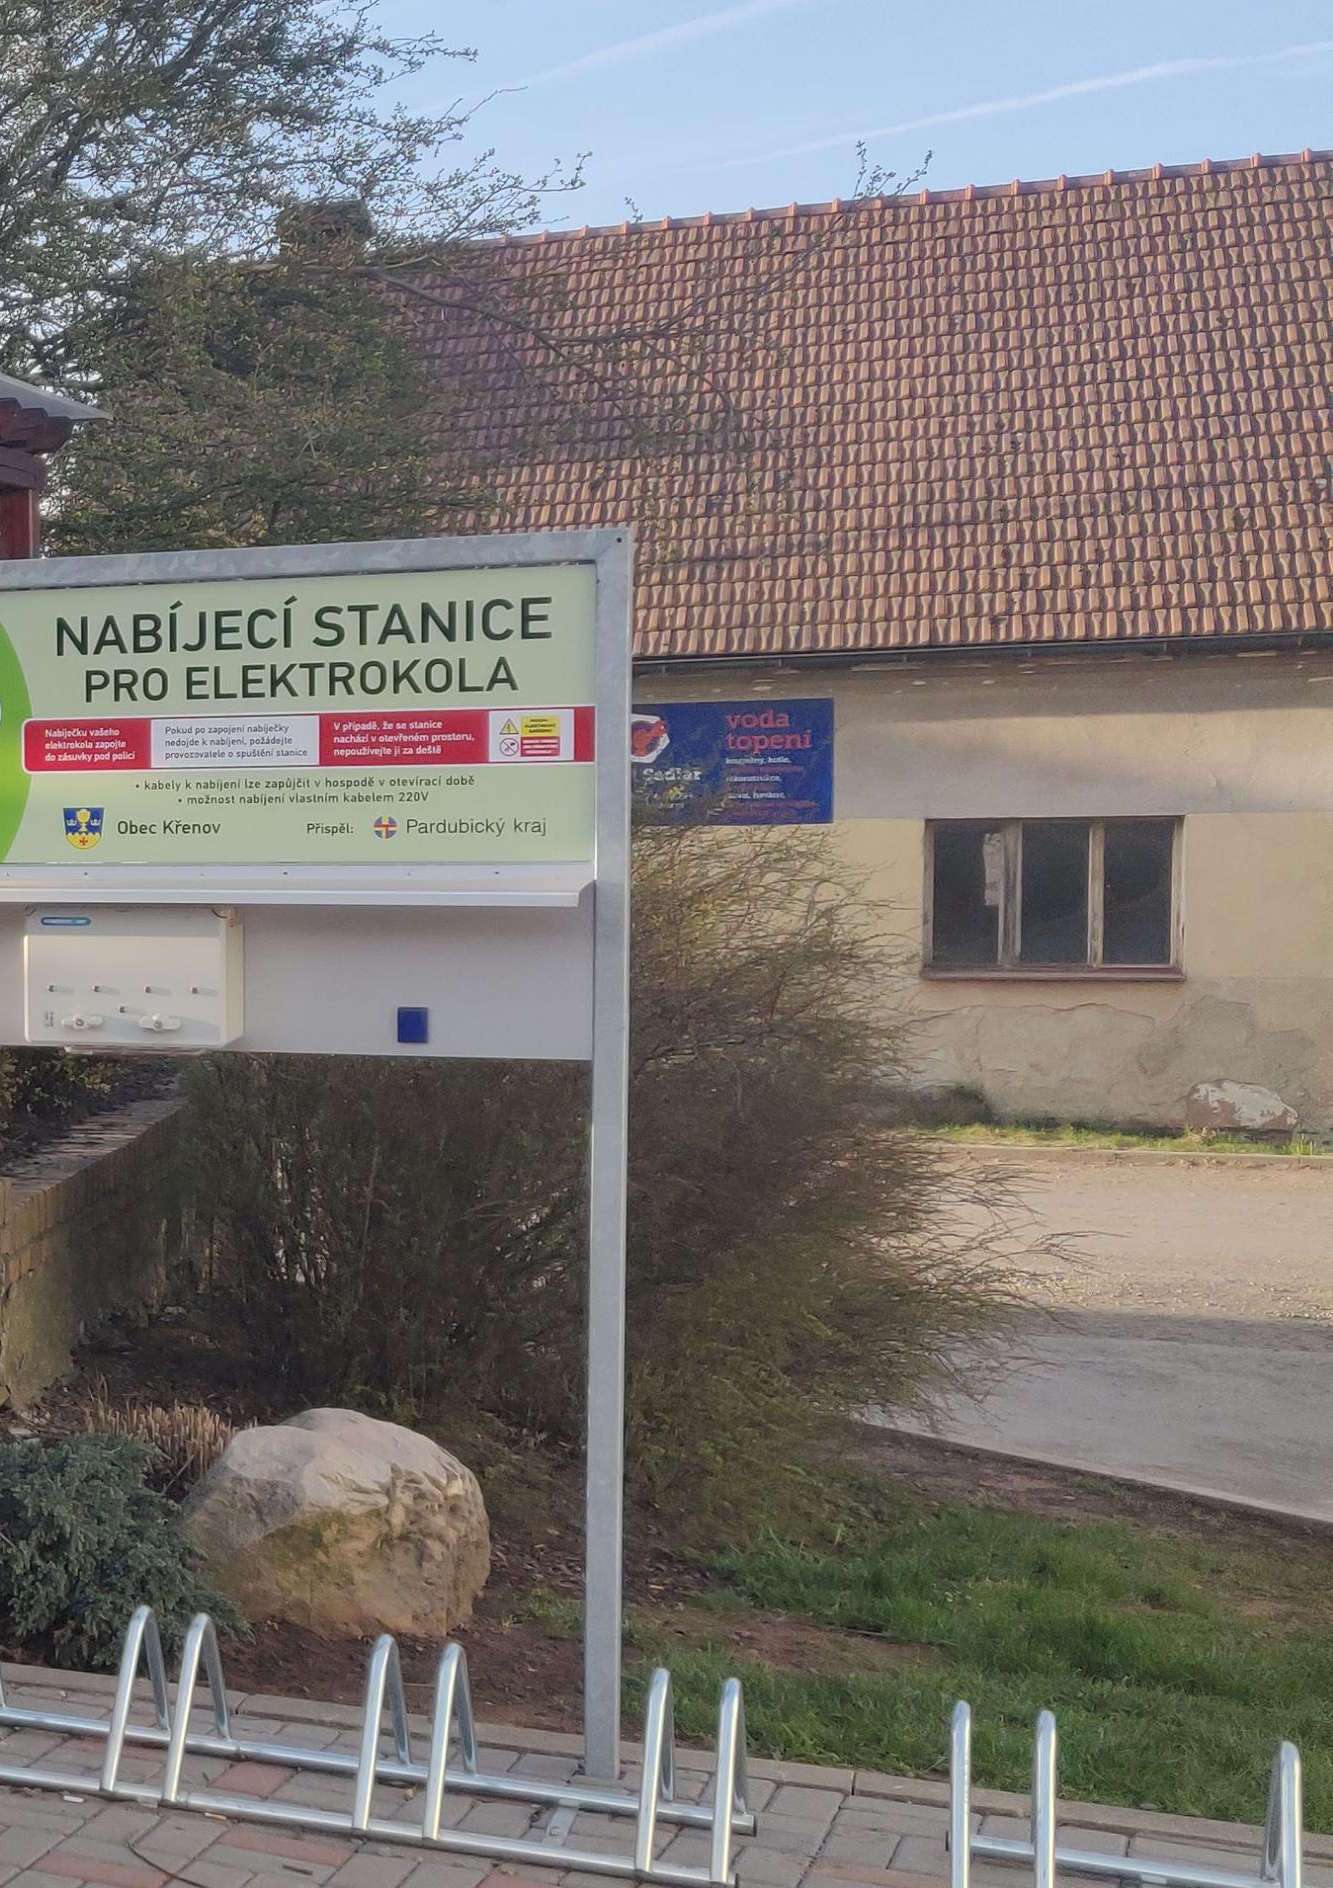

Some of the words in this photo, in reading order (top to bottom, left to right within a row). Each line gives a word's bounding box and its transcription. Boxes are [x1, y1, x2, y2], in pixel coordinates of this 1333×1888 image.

[56, 595, 298, 657] NABÍJECÍ
[312, 596, 553, 648] STANICE
[85, 668, 169, 703] PRO
[185, 656, 519, 700] ELEKTROKOLA
[334, 721, 341, 730] V
[382, 720, 394, 730] že
[395, 722, 407, 730] se
[409, 719, 443, 730] stanice
[725, 709, 790, 729] voda
[44, 727, 87, 739] Nabíječku
[88, 727, 120, 737] vašeho
[164, 726, 193, 735] Pokud
[195, 727, 206, 736] po
[207, 724, 245, 735] zapojení
[246, 723, 290, 735] nabíječky
[44, 740, 93, 750] elektrokola
[94, 739, 127, 750] zapojte
[164, 738, 200, 748] nedojde
[202, 738, 208, 746] k
[249, 735, 293, 747] požádejte
[333, 733, 369, 744] nachází
[371, 735, 377, 743] v
[378, 732, 429, 743] otevřeném
[431, 732, 475, 743] prostoru,
[725, 729, 813, 755] topení
[44, 752, 56, 761] do
[57, 752, 93, 762] zásuvky
[94, 751, 111, 762] pod
[164, 749, 226, 760] provozovatele
[236, 748, 274, 759] spuštění
[275, 748, 308, 757] stanice
[333, 746, 392, 757] nepoužívejte
[402, 747, 414, 755] za
[415, 744, 442, 755] deště
[144, 779, 182, 792] kabely
[185, 779, 192, 790] k
[195, 778, 241, 792] nabíjení
[244, 778, 261, 789] lze
[264, 777, 311, 791] zapůjčit
[314, 779, 321, 788] v
[325, 776, 375, 790] hospodě
[378, 778, 385, 787] v
[389, 775, 442, 787] otevírací
[445, 774, 476, 787] době
[186, 793, 236, 804] možnost
[239, 792, 285, 806] nabíjení
[288, 791, 339, 804] vlastním
[343, 791, 395, 803] kabelem
[398, 791, 430, 802] 220V
[117, 819, 158, 835] Obec
[162, 818, 222, 835] Křenov
[306, 821, 355, 837] Přispěl:
[405, 817, 506, 838] Pardubický
[513, 816, 547, 837] kraj
